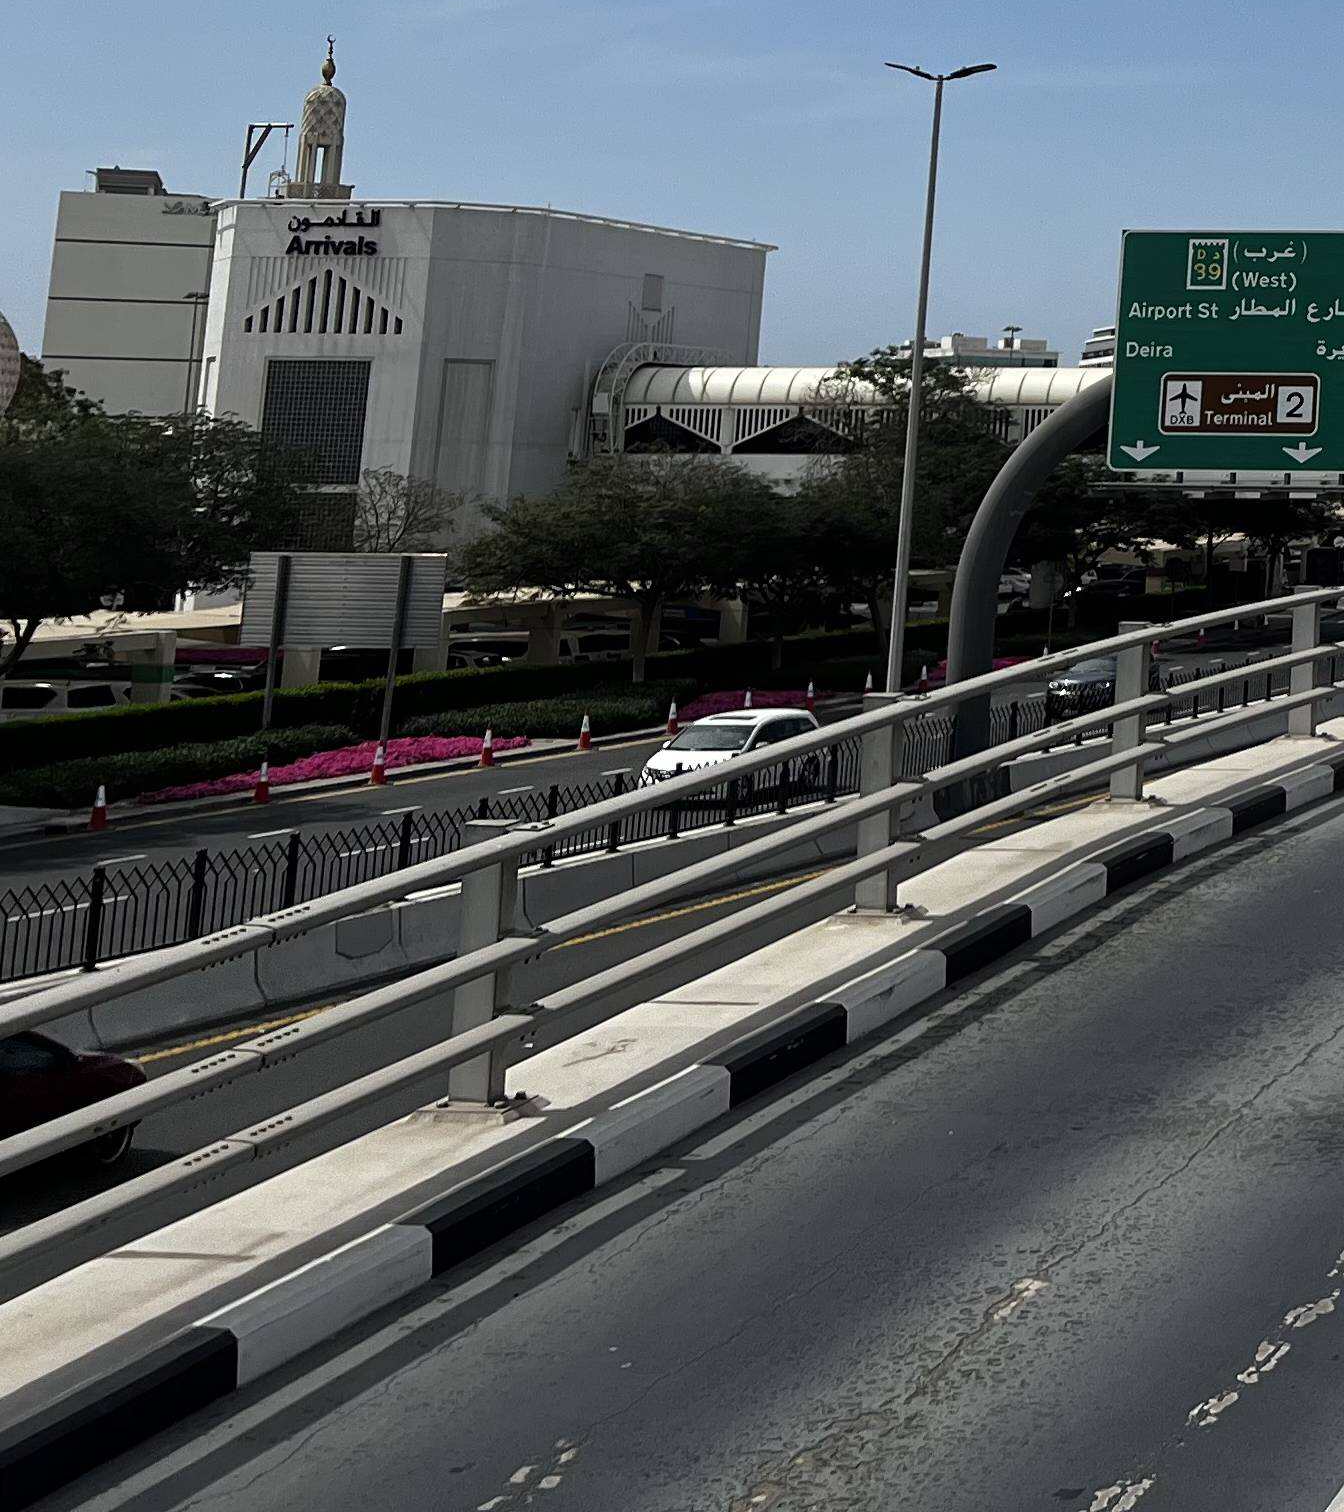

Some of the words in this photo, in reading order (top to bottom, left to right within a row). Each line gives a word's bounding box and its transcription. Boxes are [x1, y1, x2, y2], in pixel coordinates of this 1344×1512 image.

[288, 209, 381, 233] القادمون
[285, 235, 378, 256] Arrivals
[1231, 272, 1297, 292] (West)
[1128, 302, 1193, 321] Airport
[1198, 302, 1219, 319] St
[1228, 298, 1296, 320] المطار
[1126, 341, 1173, 358] Deira
[1285, 391, 1305, 418] 2
[1170, 414, 1194, 426] DXB
[1204, 410, 1273, 427] Terminal
